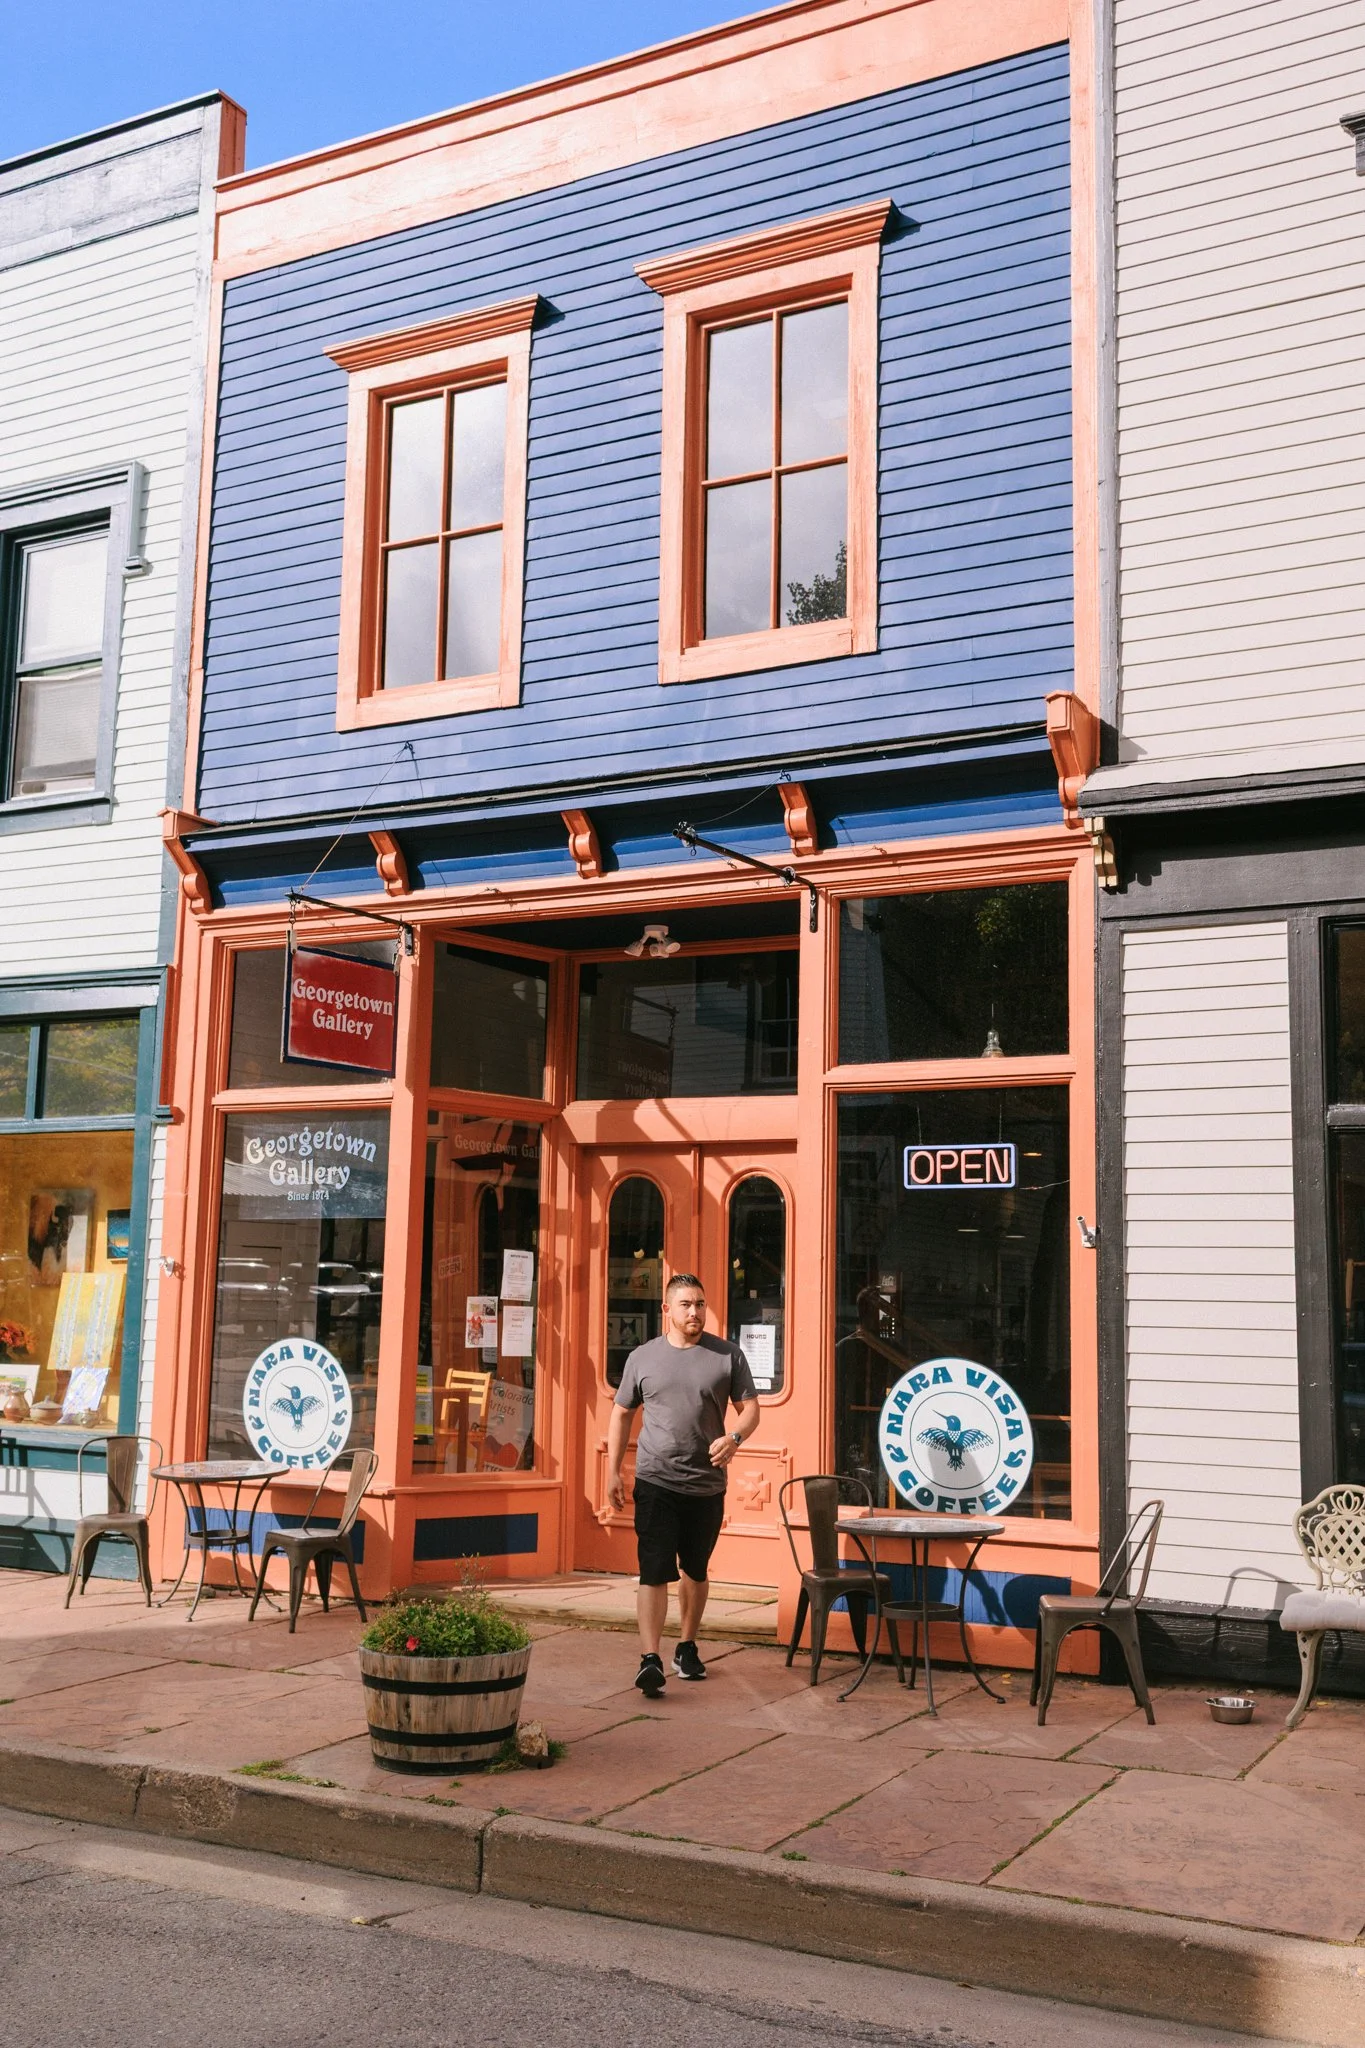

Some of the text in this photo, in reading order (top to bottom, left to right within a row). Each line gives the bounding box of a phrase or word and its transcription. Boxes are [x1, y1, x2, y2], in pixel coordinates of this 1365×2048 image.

[293, 978, 392, 1016] Georgetown
[312, 1008, 374, 1040] Gallery
[246, 1126, 377, 1163] Georgetown
[454, 1134, 517, 1157] Georgetown
[269, 1158, 351, 1190] Gallery
[910, 1148, 1009, 1184] OPEN
[287, 1190, 309, 1201] Since
[249, 1345, 345, 1407] NARA VISA
[493, 1386, 534, 1405] Colorado
[887, 1366, 1024, 1440] NARA VISA
[258, 1431, 342, 1469] COFFEE
[898, 1473, 1018, 1515] COFFEE
